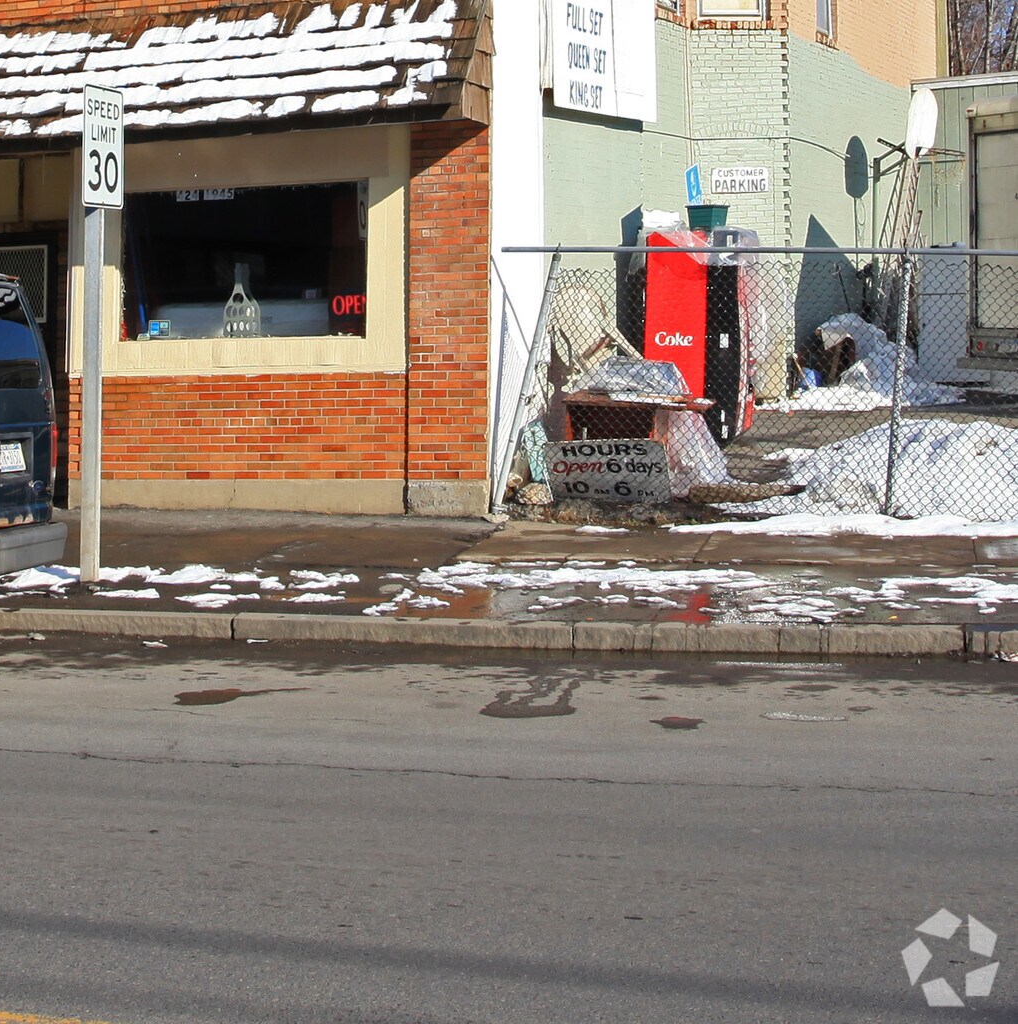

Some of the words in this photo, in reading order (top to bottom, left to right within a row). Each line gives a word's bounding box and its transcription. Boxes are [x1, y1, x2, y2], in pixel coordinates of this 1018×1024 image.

[566, 2, 587, 33] FULL
[589, 8, 604, 36] SET
[568, 42, 590, 70] QUEEN
[593, 47, 607, 74] SET
[569, 79, 589, 108] KING
[590, 84, 603, 109] SET
[87, 98, 120, 120] SPEED
[91, 123, 116, 145] LIMIT
[88, 149, 119, 194] 30
[718, 169, 764, 178] CUSTOMER
[177, 190, 198, 201] 424
[205, 188, 233, 199] 1945
[715, 179, 766, 192] PARKING
[654, 331, 693, 346] Coke
[561, 443, 647, 457] HOURS
[552, 460, 607, 476] Open
[606, 458, 622, 473] 6
[625, 458, 663, 477] days
[563, 481, 590, 494] 10
[614, 481, 632, 496] 6
[637, 489, 655, 497] PM
